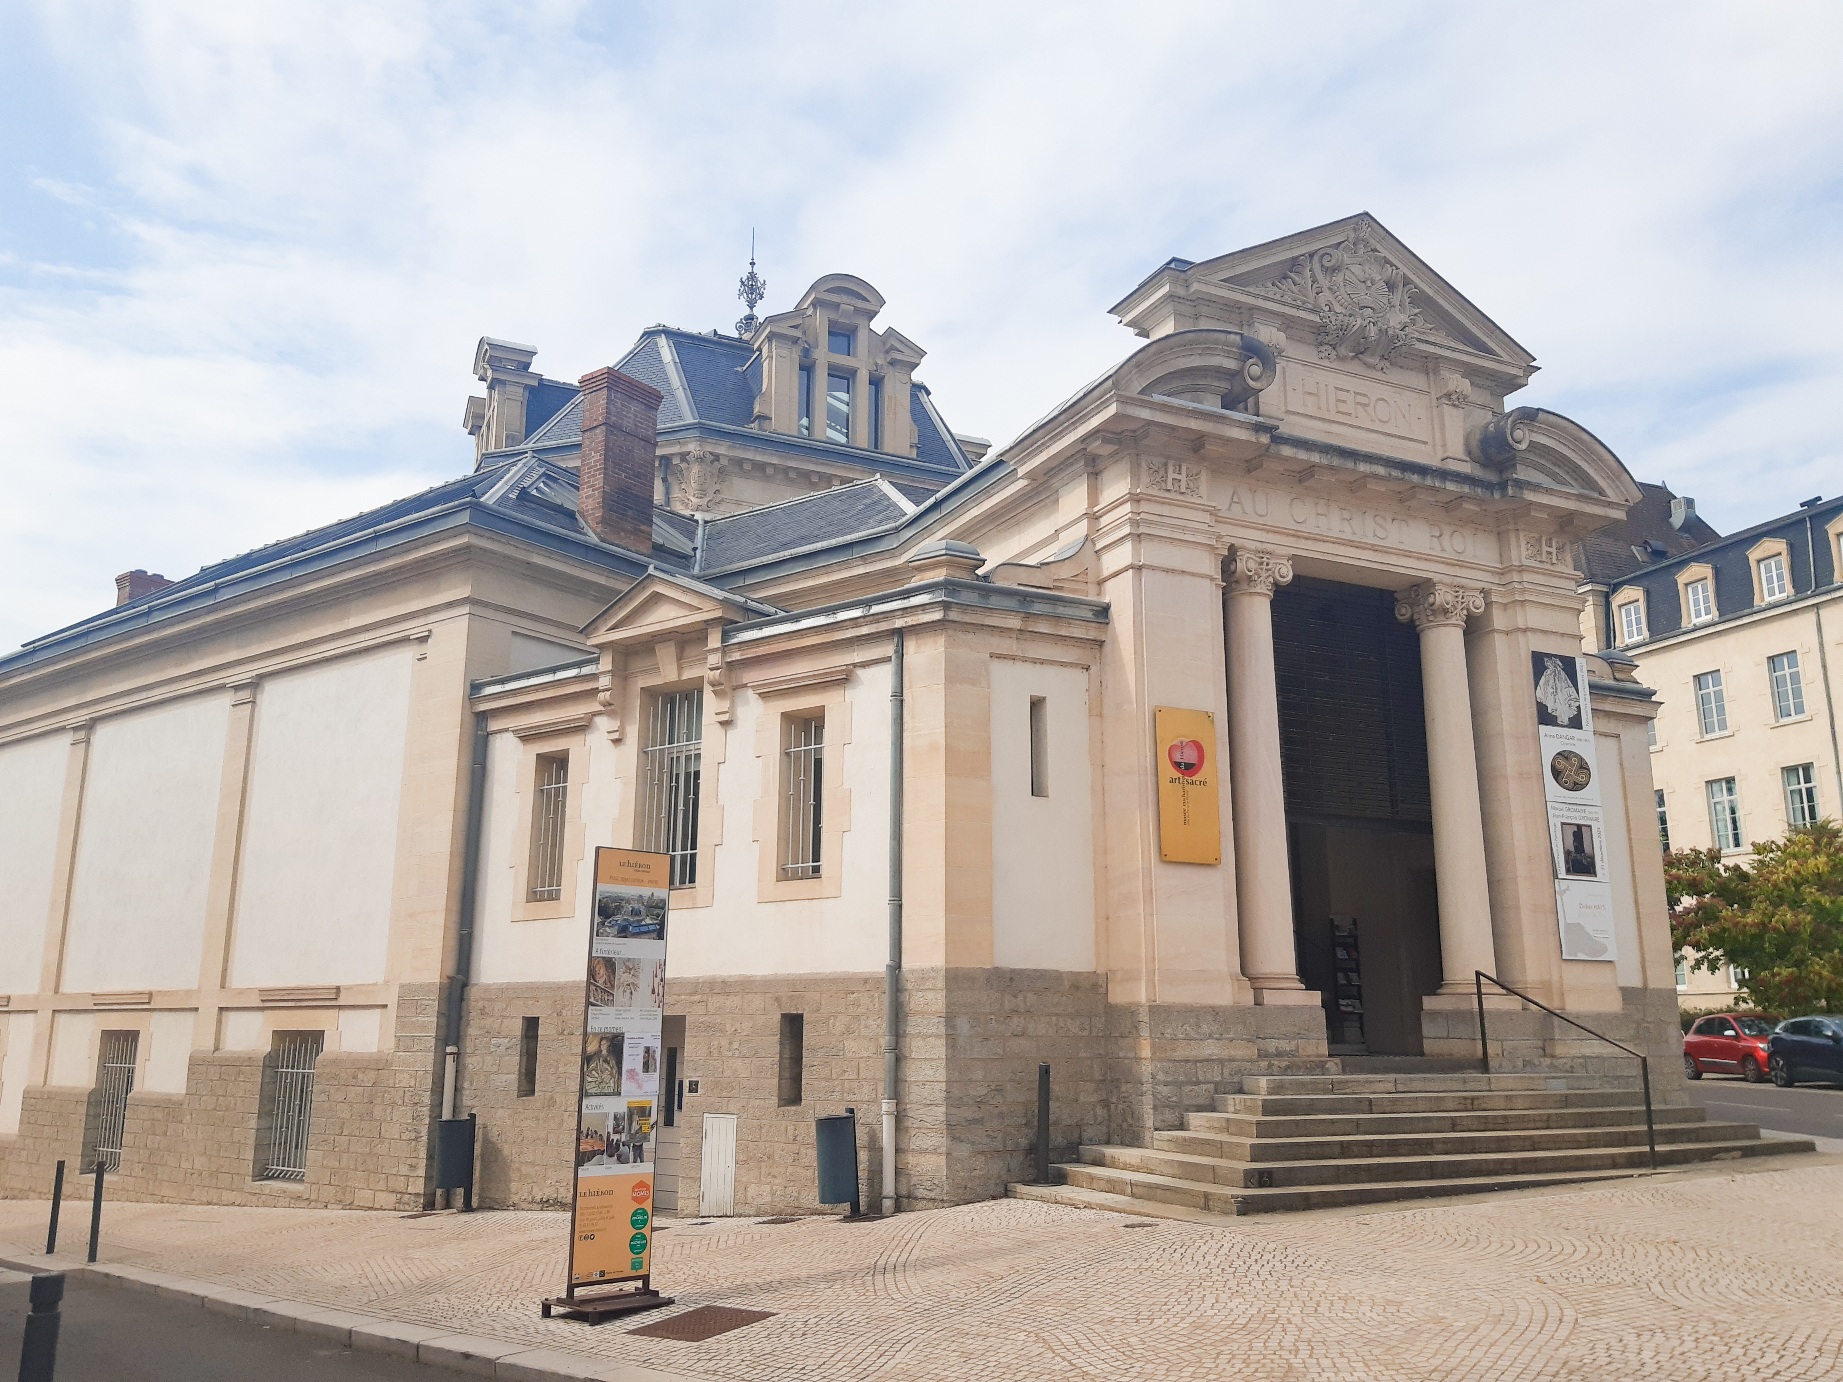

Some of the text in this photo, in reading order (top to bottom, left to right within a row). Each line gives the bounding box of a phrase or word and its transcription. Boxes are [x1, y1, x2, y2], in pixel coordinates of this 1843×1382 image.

[1301, 378, 1415, 434] HIERON
[1225, 487, 1481, 558] AU CHRIST ROI
[1169, 776, 1208, 787] art sacré
